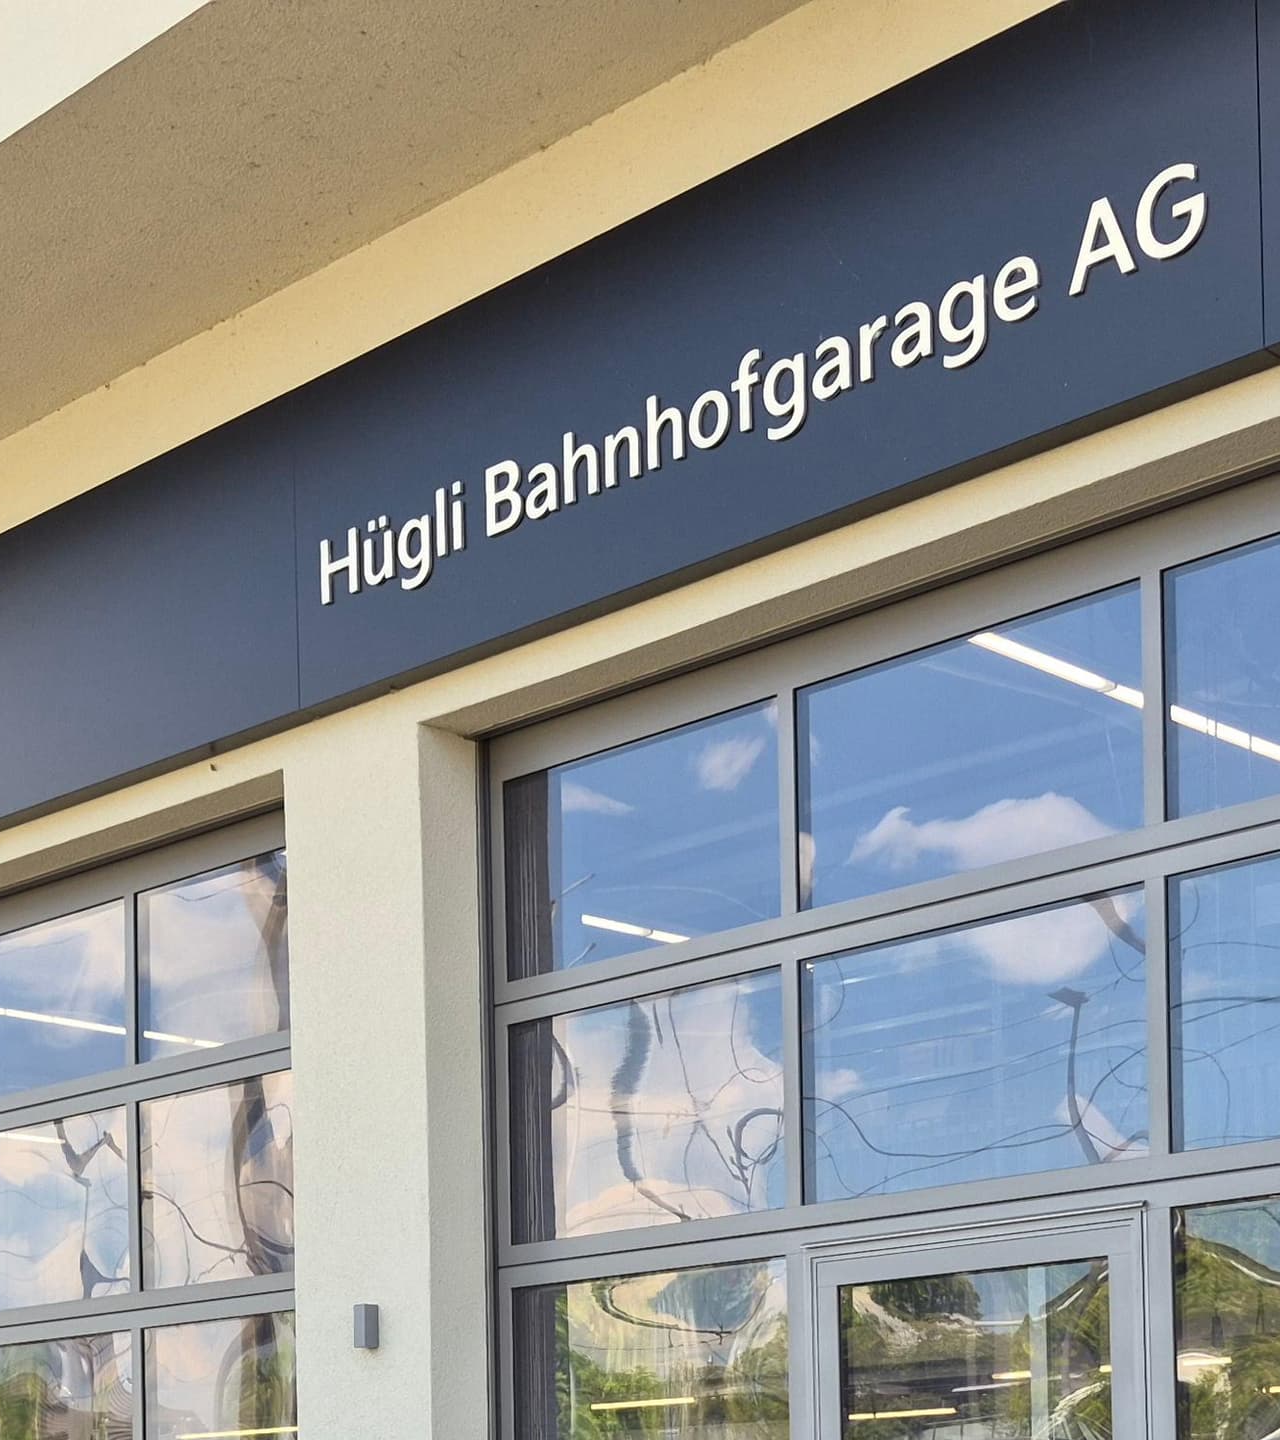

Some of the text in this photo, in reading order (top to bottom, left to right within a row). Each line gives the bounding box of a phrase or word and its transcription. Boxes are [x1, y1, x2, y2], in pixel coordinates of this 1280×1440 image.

[317, 162, 1208, 605] Hügli Bahnhofgarage AG
